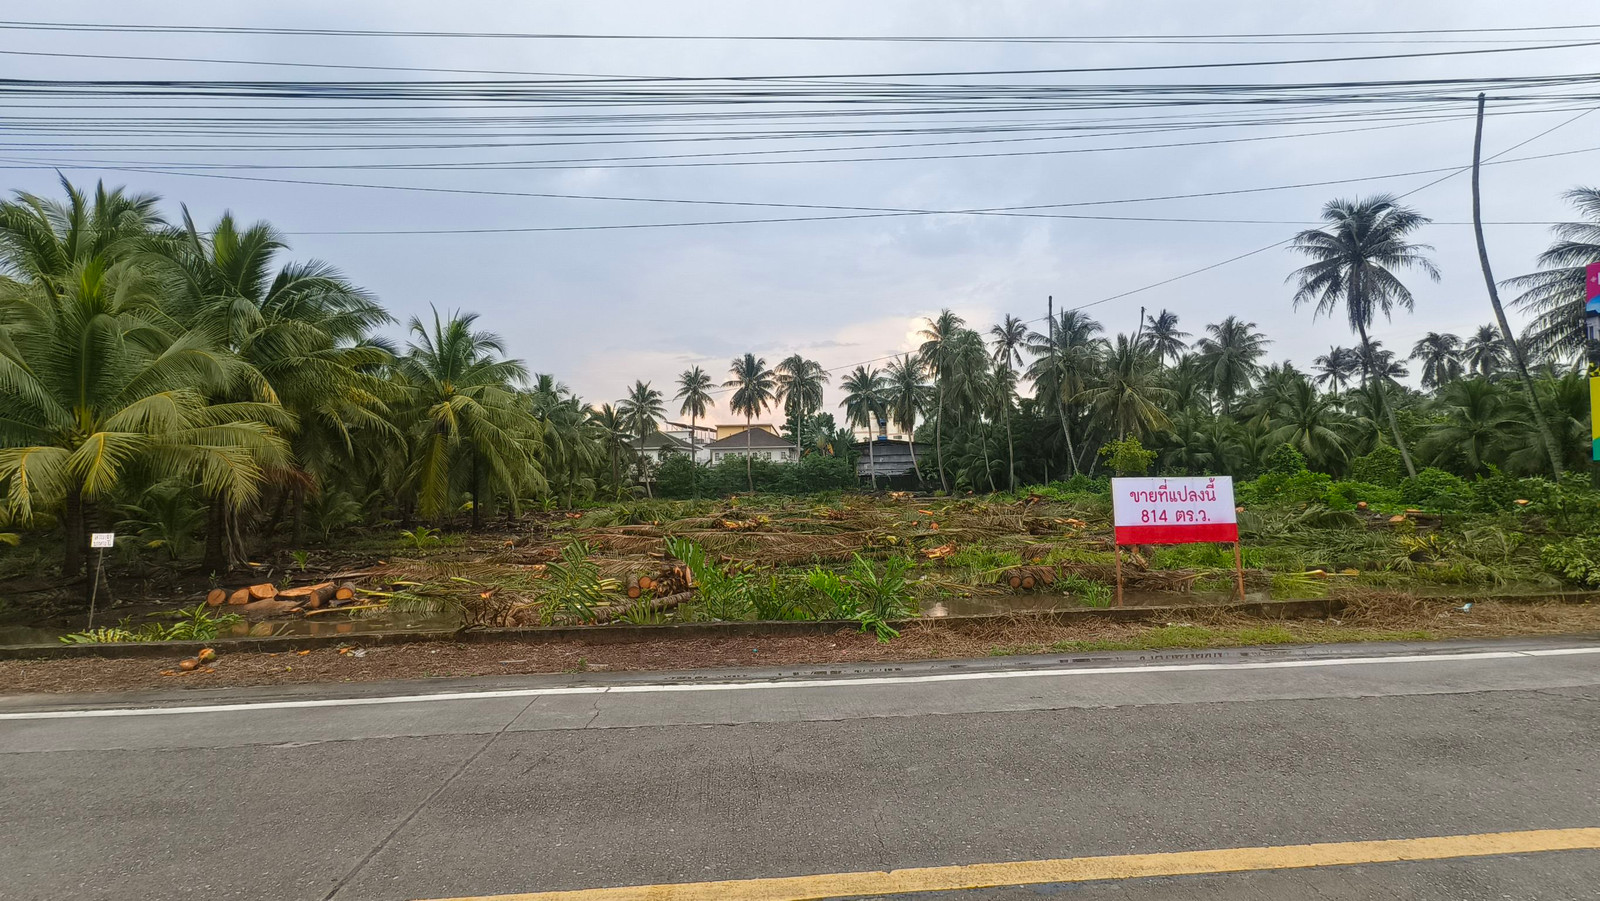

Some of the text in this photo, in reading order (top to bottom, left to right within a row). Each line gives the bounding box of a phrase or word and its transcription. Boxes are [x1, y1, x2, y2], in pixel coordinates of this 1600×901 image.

[1129, 478, 1217, 502] ขายที่แปลงนี้
[1141, 509, 1211, 523] 814 ตร.ว.
